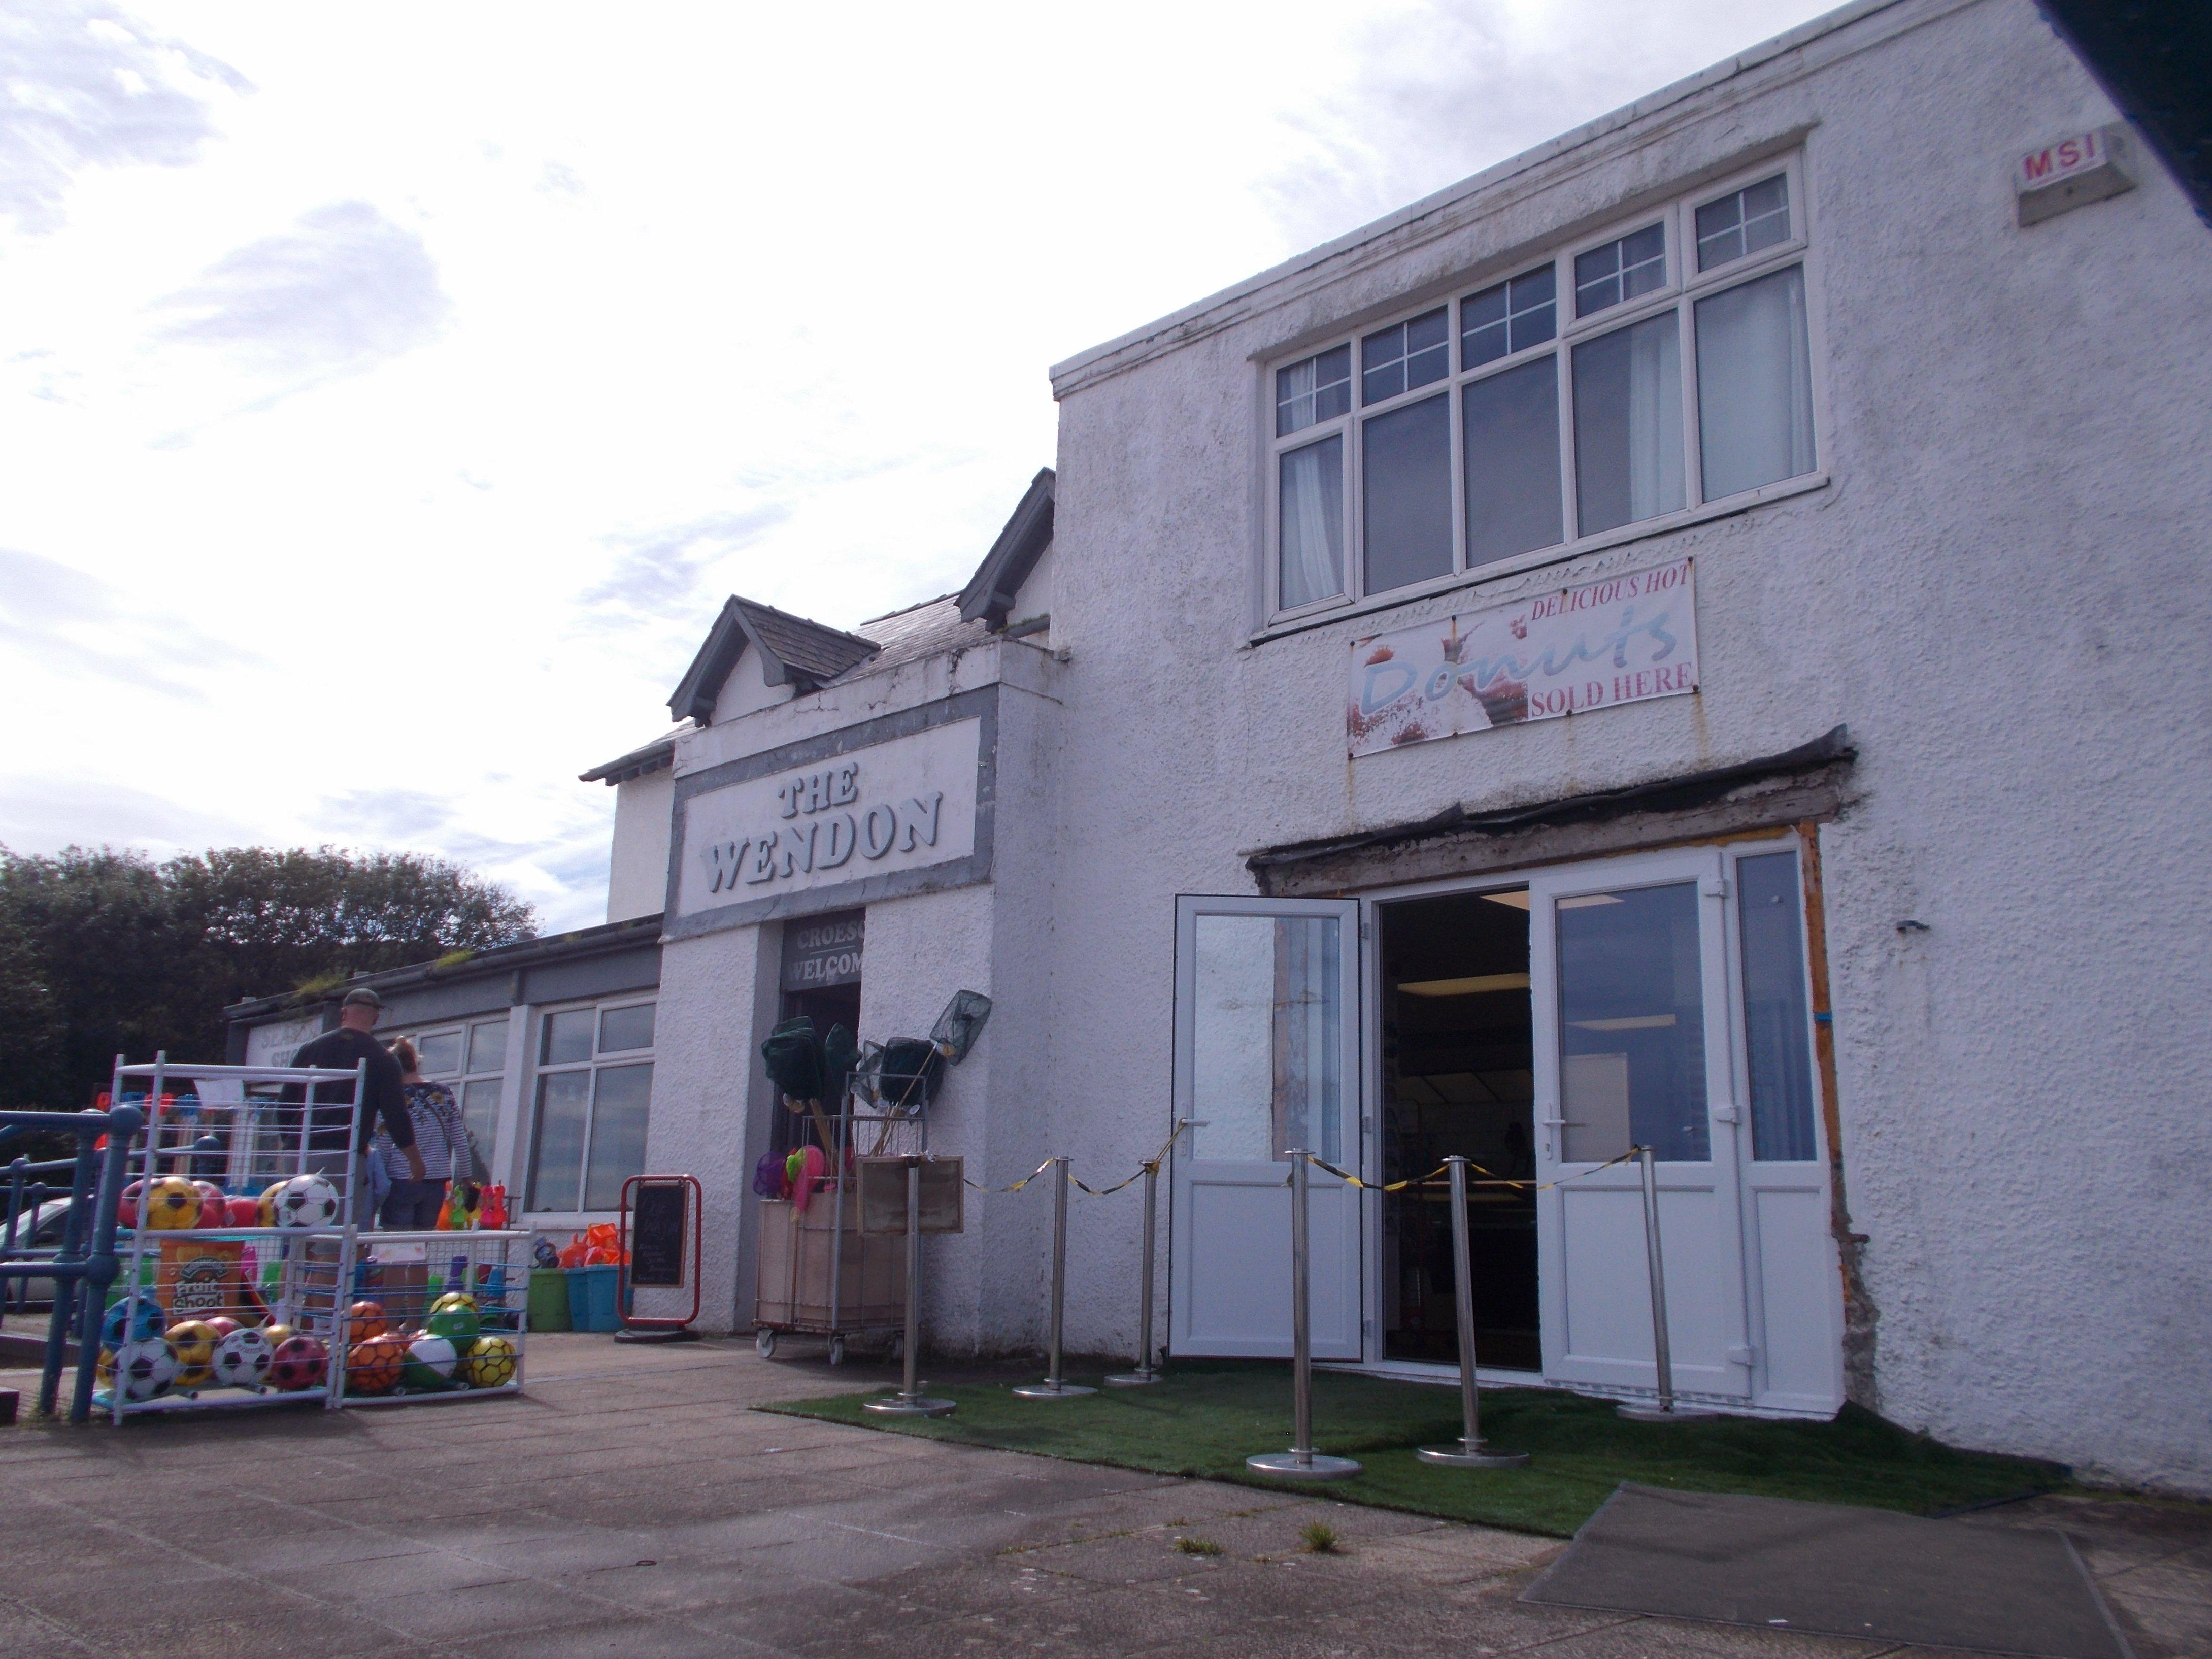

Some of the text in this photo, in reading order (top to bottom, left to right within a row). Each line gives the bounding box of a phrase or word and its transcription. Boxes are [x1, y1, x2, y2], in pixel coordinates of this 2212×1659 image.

[2025, 133, 2094, 180] MSI
[1531, 563, 1691, 620] DELICIOUS HOT
[1361, 604, 1677, 715] Donuts
[1530, 662, 1694, 717] SOLD HERE
[778, 762, 859, 819] THE
[701, 791, 943, 893] WENDON
[176, 1277, 218, 1297] Fruit
